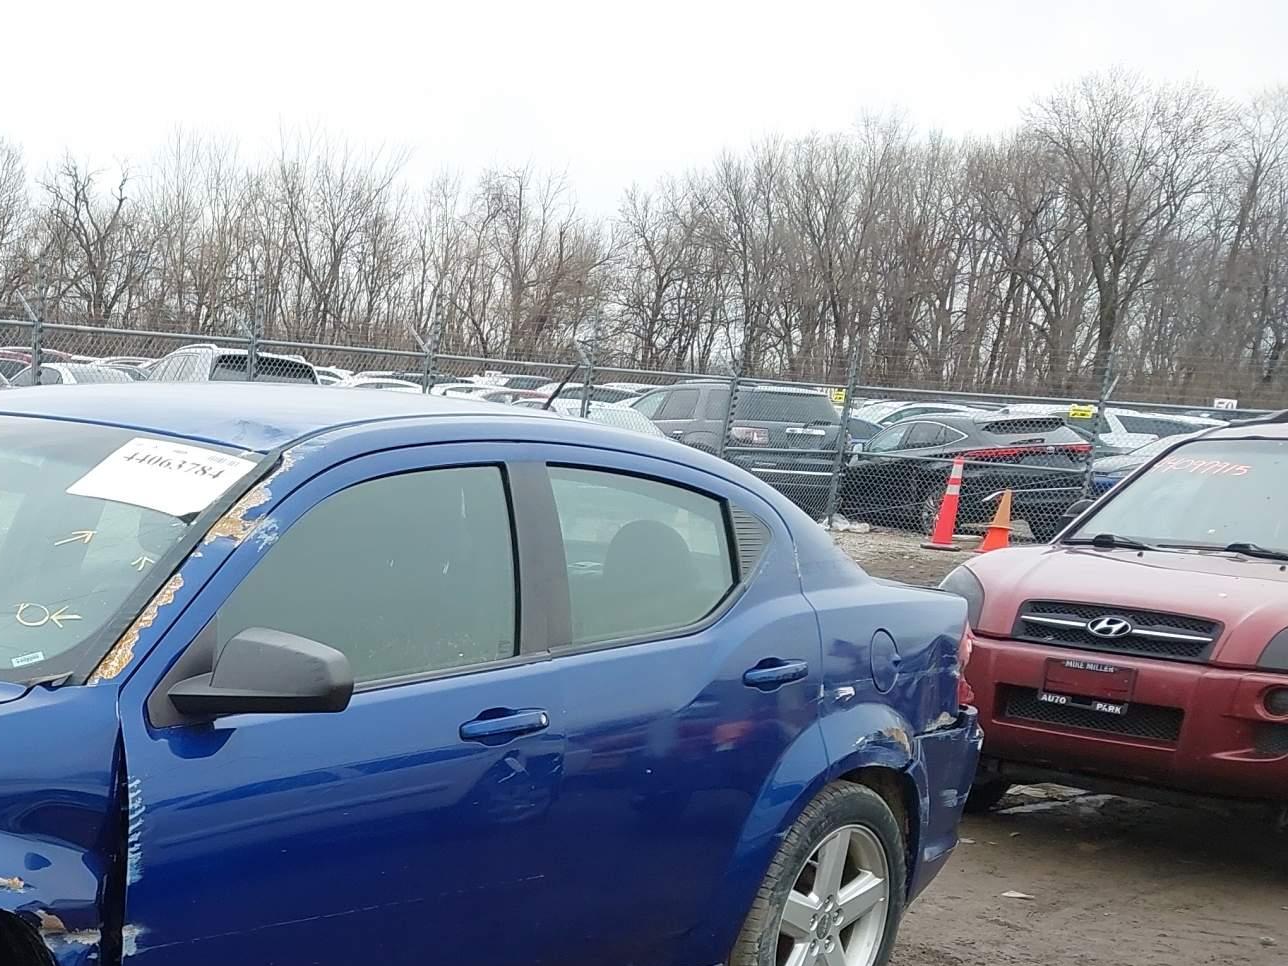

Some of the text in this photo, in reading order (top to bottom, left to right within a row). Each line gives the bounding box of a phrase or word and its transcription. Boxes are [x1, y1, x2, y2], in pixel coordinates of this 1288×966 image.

[123, 450, 225, 480] 44063784
[1065, 660, 1114, 673] MIKE MILLER
[1040, 693, 1122, 715] AUTO PARK
